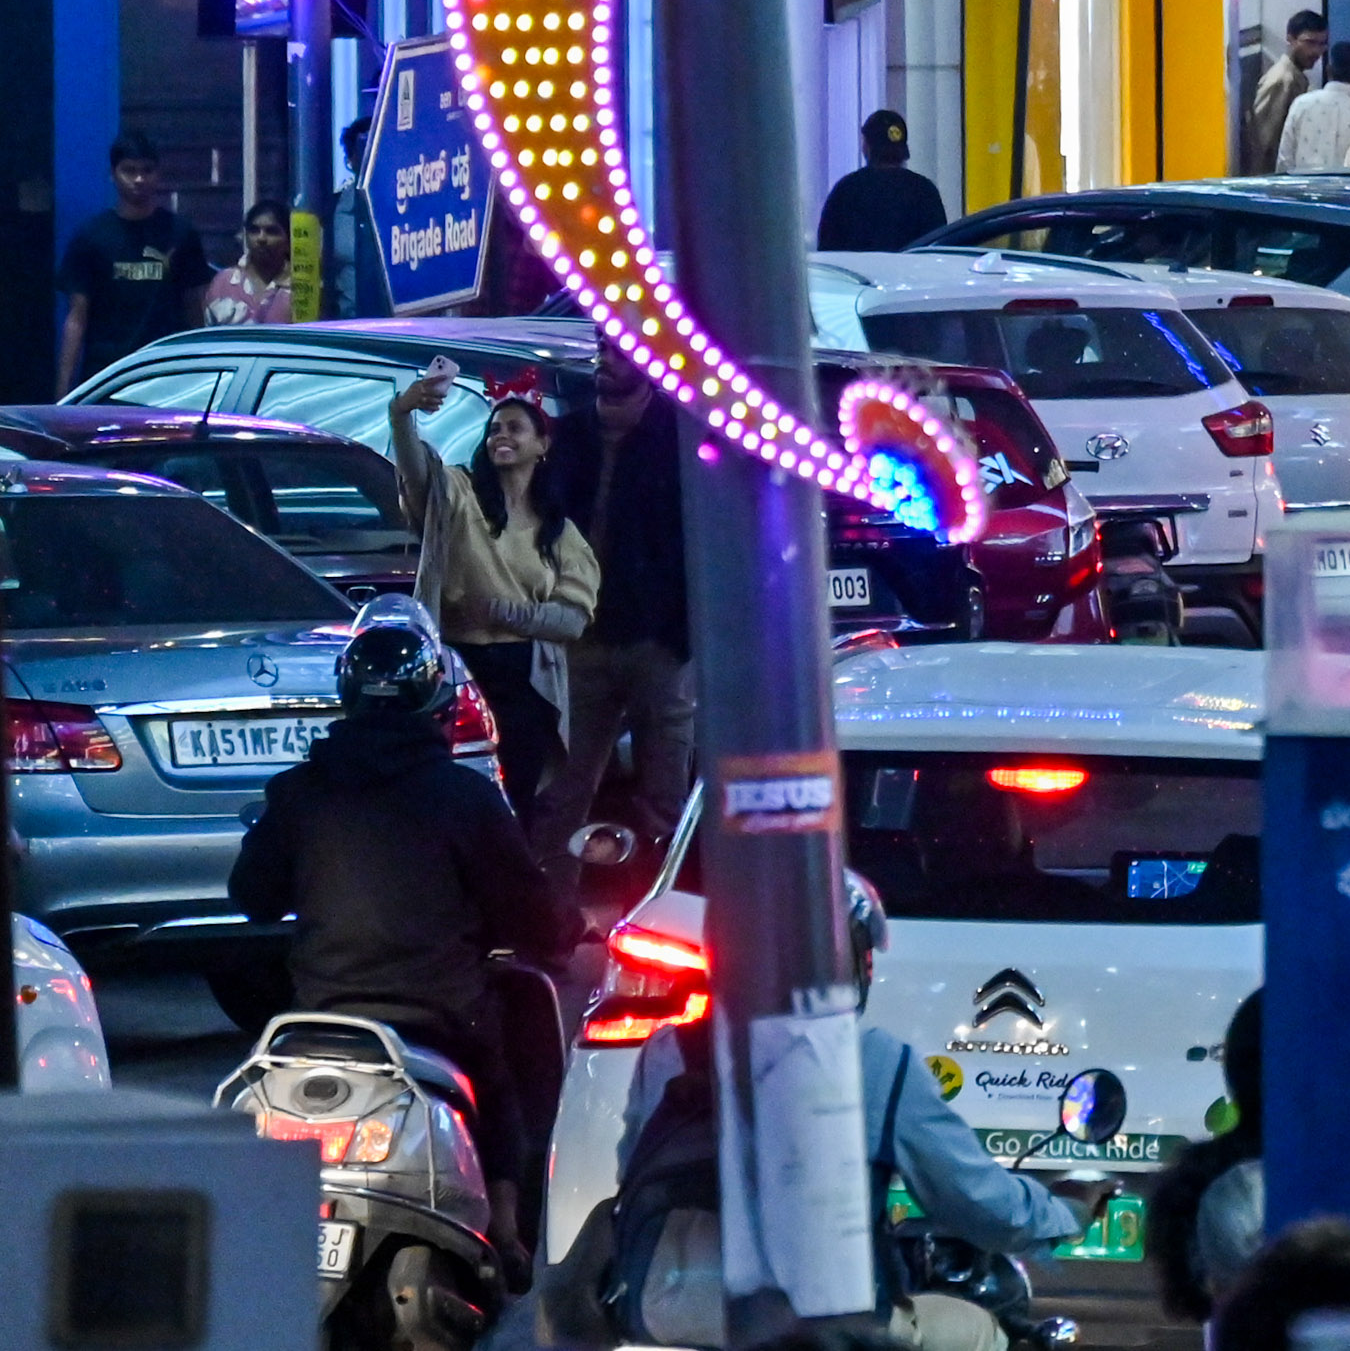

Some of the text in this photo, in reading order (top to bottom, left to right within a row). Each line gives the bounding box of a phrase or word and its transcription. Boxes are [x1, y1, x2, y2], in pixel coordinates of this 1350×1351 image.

[391, 207, 477, 272] Brigade Road
[831, 575, 868, 601] 003
[975, 1069, 1032, 1094] Quick
[985, 1132, 1021, 1158] Go
